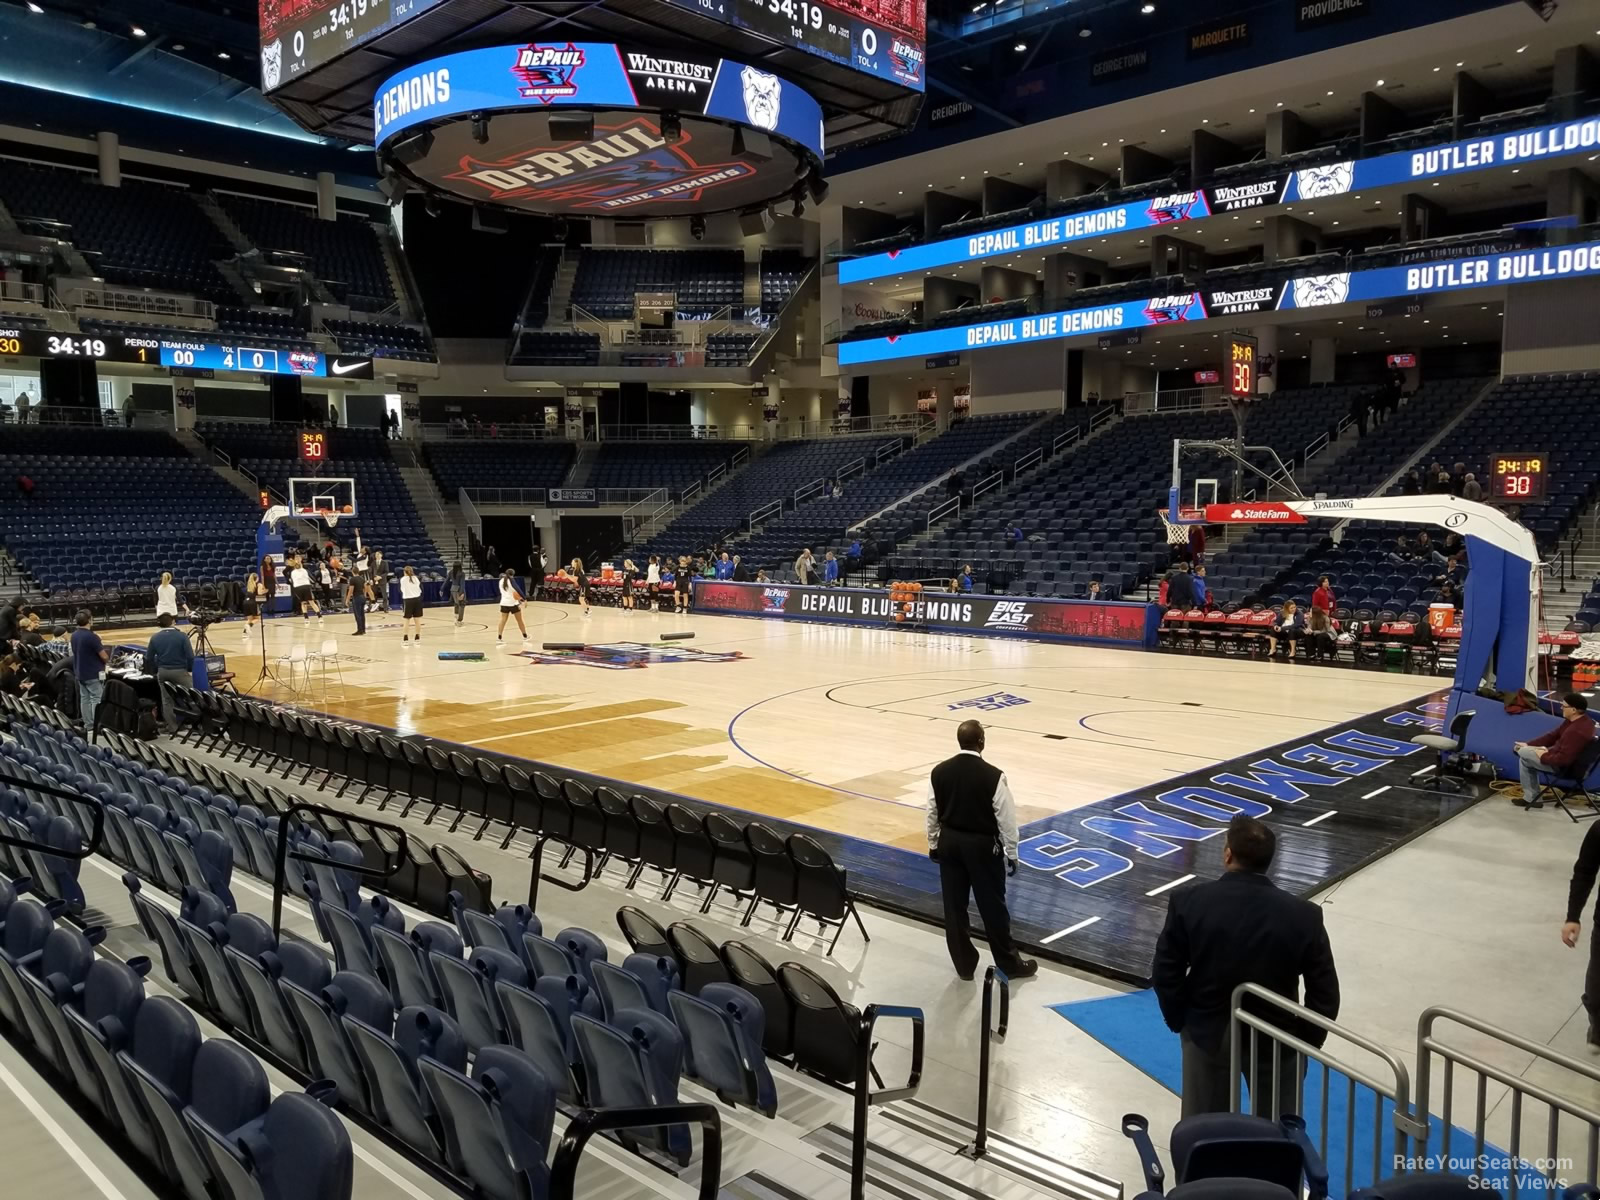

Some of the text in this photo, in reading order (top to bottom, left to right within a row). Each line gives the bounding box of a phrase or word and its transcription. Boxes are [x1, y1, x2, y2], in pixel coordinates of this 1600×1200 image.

[330, 0, 367, 32] 34:19
[395, 4, 407, 16] TOL
[718, 4, 724, 14] 4
[768, 0, 822, 29] 34:19
[345, 28, 354, 40] 1st
[790, 26, 803, 39] 1st
[828, 23, 836, 34] 00
[293, 30, 305, 57] 0
[861, 28, 877, 56] 0
[1191, 24, 1247, 50] MARQUETTE
[290, 59, 306, 73] TOL 4
[627, 53, 712, 79] WINTRUST
[858, 56, 878, 70] TOL 4
[1093, 51, 1148, 77] GEORGETOWN
[646, 77, 697, 93] ARENA
[383, 68, 451, 126] DEMONS
[931, 102, 973, 121] CREIGHTON
[1411, 121, 1600, 177] BUTLER BULLDO
[604, 168, 741, 208] BLUE DEMONS
[1214, 180, 1277, 200] WINTRUST
[1226, 197, 1264, 210] ARENA
[969, 208, 1127, 257] DEPAUL BLUE DEMONS
[1406, 259, 1489, 291] BUTLER
[1211, 287, 1274, 306] WINTRUST
[1222, 302, 1260, 315] ARENA
[1368, 304, 1421, 317] 109 110
[967, 307, 1124, 346] DEPAUL BLUE DEMONS
[0, 338, 19, 353] 30
[47, 336, 106, 357] 34:19
[125, 338, 158, 348] PERIOD
[162, 341, 205, 351] TEAM FOULS
[1127, 336, 1139, 344] 109
[138, 348, 147, 362] 1
[174, 350, 194, 366] 00
[223, 354, 234, 368] 4
[252, 352, 264, 369] 0
[172, 368, 184, 377] 102
[1234, 363, 1250, 392] 30
[302, 433, 323, 442] 34:19
[305, 443, 321, 457] 30
[1497, 459, 1541, 474] 34:19
[1506, 476, 1530, 495] 30
[1313, 500, 1354, 509] SPALDING
[801, 594, 854, 614] DEPAUL
[861, 598, 898, 617] BLUE
[995, 601, 1025, 613] BIG
[987, 612, 1034, 626] EAST
[1018, 729, 1427, 889] DEMONS
